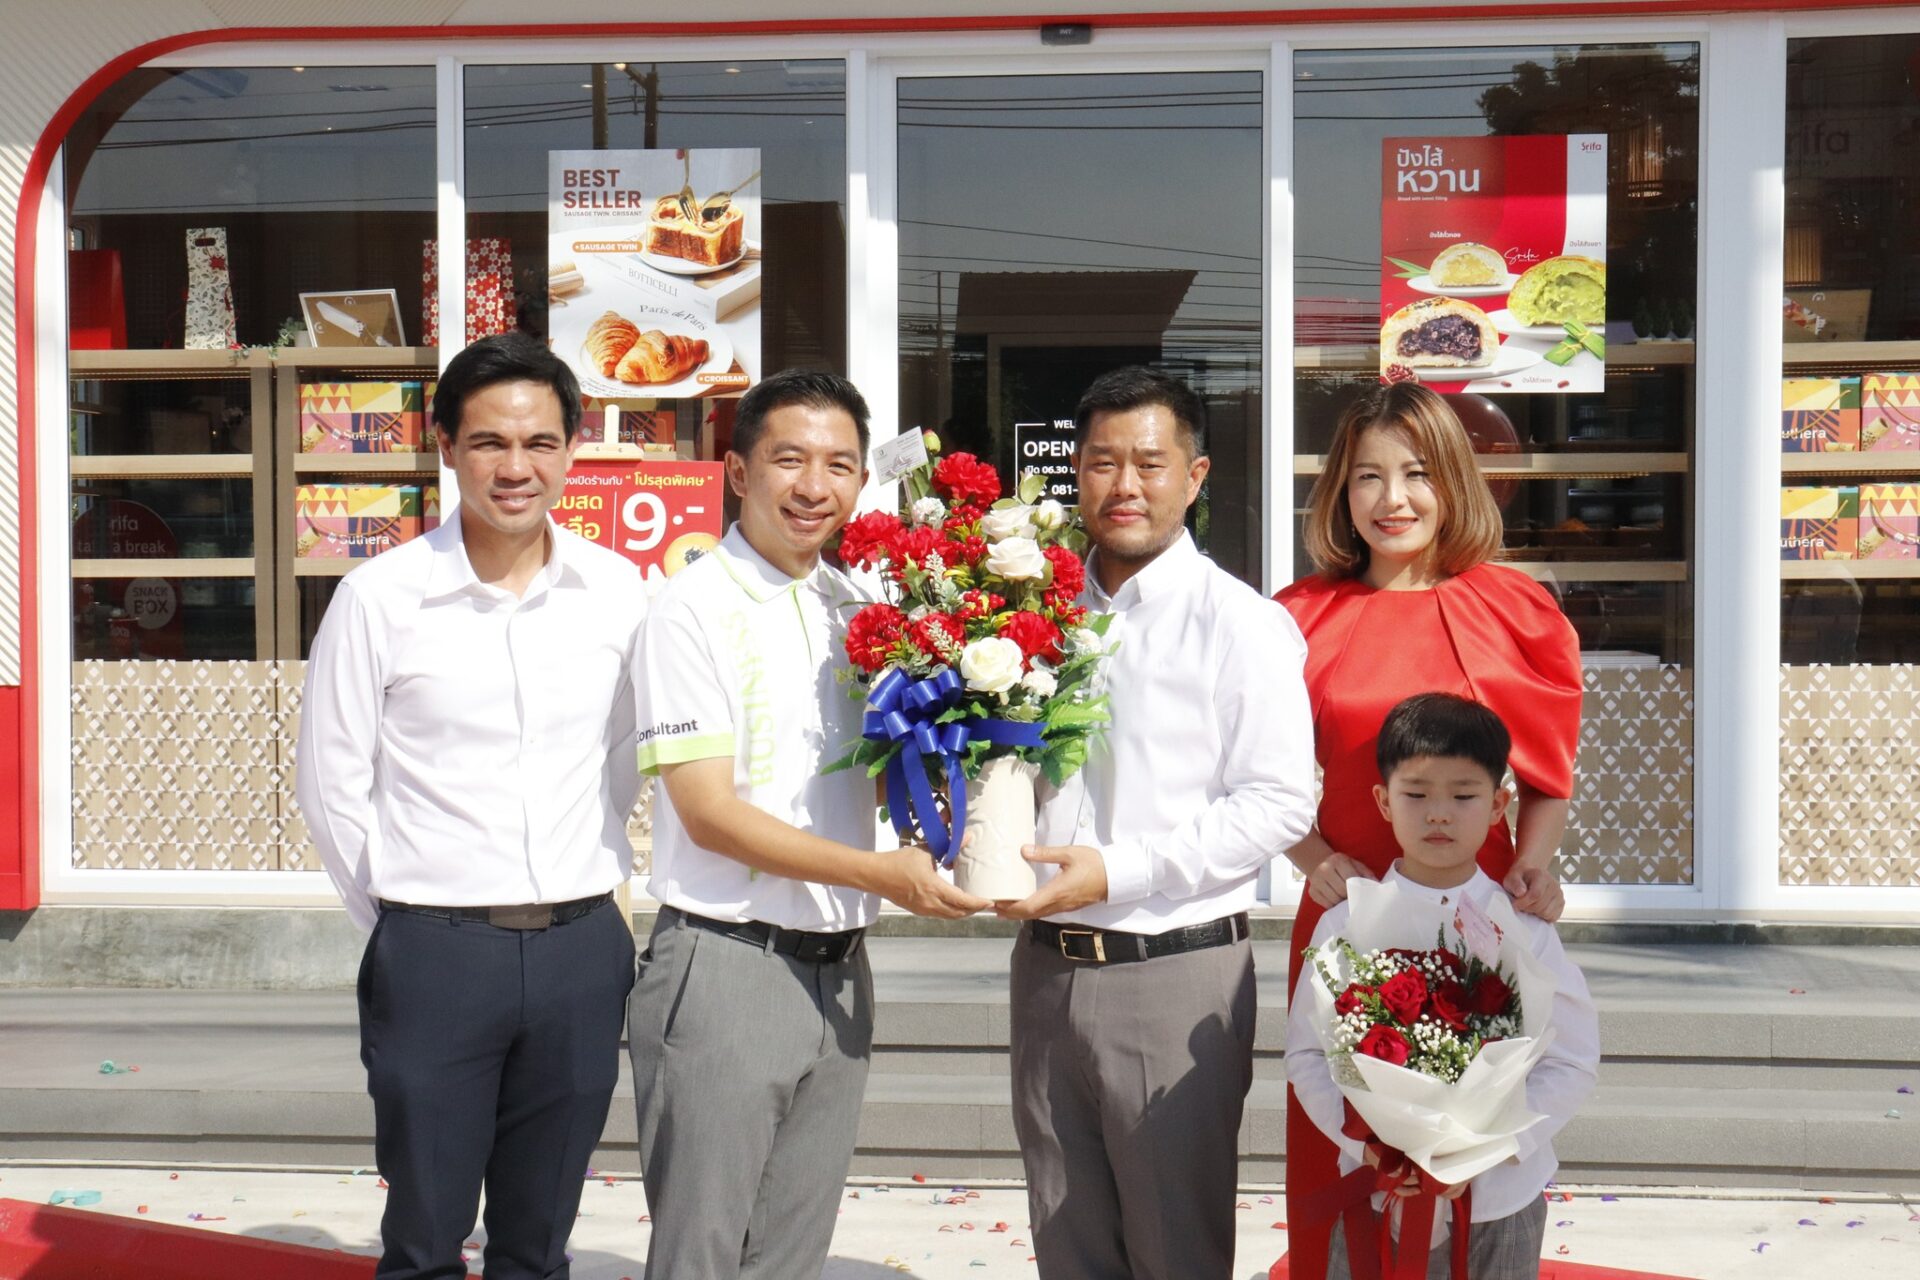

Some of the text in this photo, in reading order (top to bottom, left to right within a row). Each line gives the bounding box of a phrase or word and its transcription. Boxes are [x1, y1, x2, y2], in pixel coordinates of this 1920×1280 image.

[1397, 145, 1443, 167] ปังไส้
[563, 169, 620, 188] BEST
[1397, 169, 1480, 193] หวาน
[563, 190, 642, 209] SELLER
[579, 242, 638, 251] SAUSAGE TWIN
[628, 267, 678, 297] BOTTICELLI
[640, 304, 669, 314] Paris
[684, 313, 705, 331] Paris
[704, 375, 749, 383] CROISSANT
[1053, 419, 1076, 429] WEL
[1781, 427, 1826, 440] uthera
[1023, 440, 1075, 457] OPEN
[1042, 465, 1068, 474] 06.30
[1051, 484, 1079, 495] 081-
[110, 515, 139, 531] rifa
[113, 543, 121, 553] a
[125, 540, 166, 553] break
[339, 534, 390, 546] Suthera
[1780, 535, 1824, 548] uthera
[132, 587, 168, 597] SNACK
[134, 600, 168, 614] BOX
